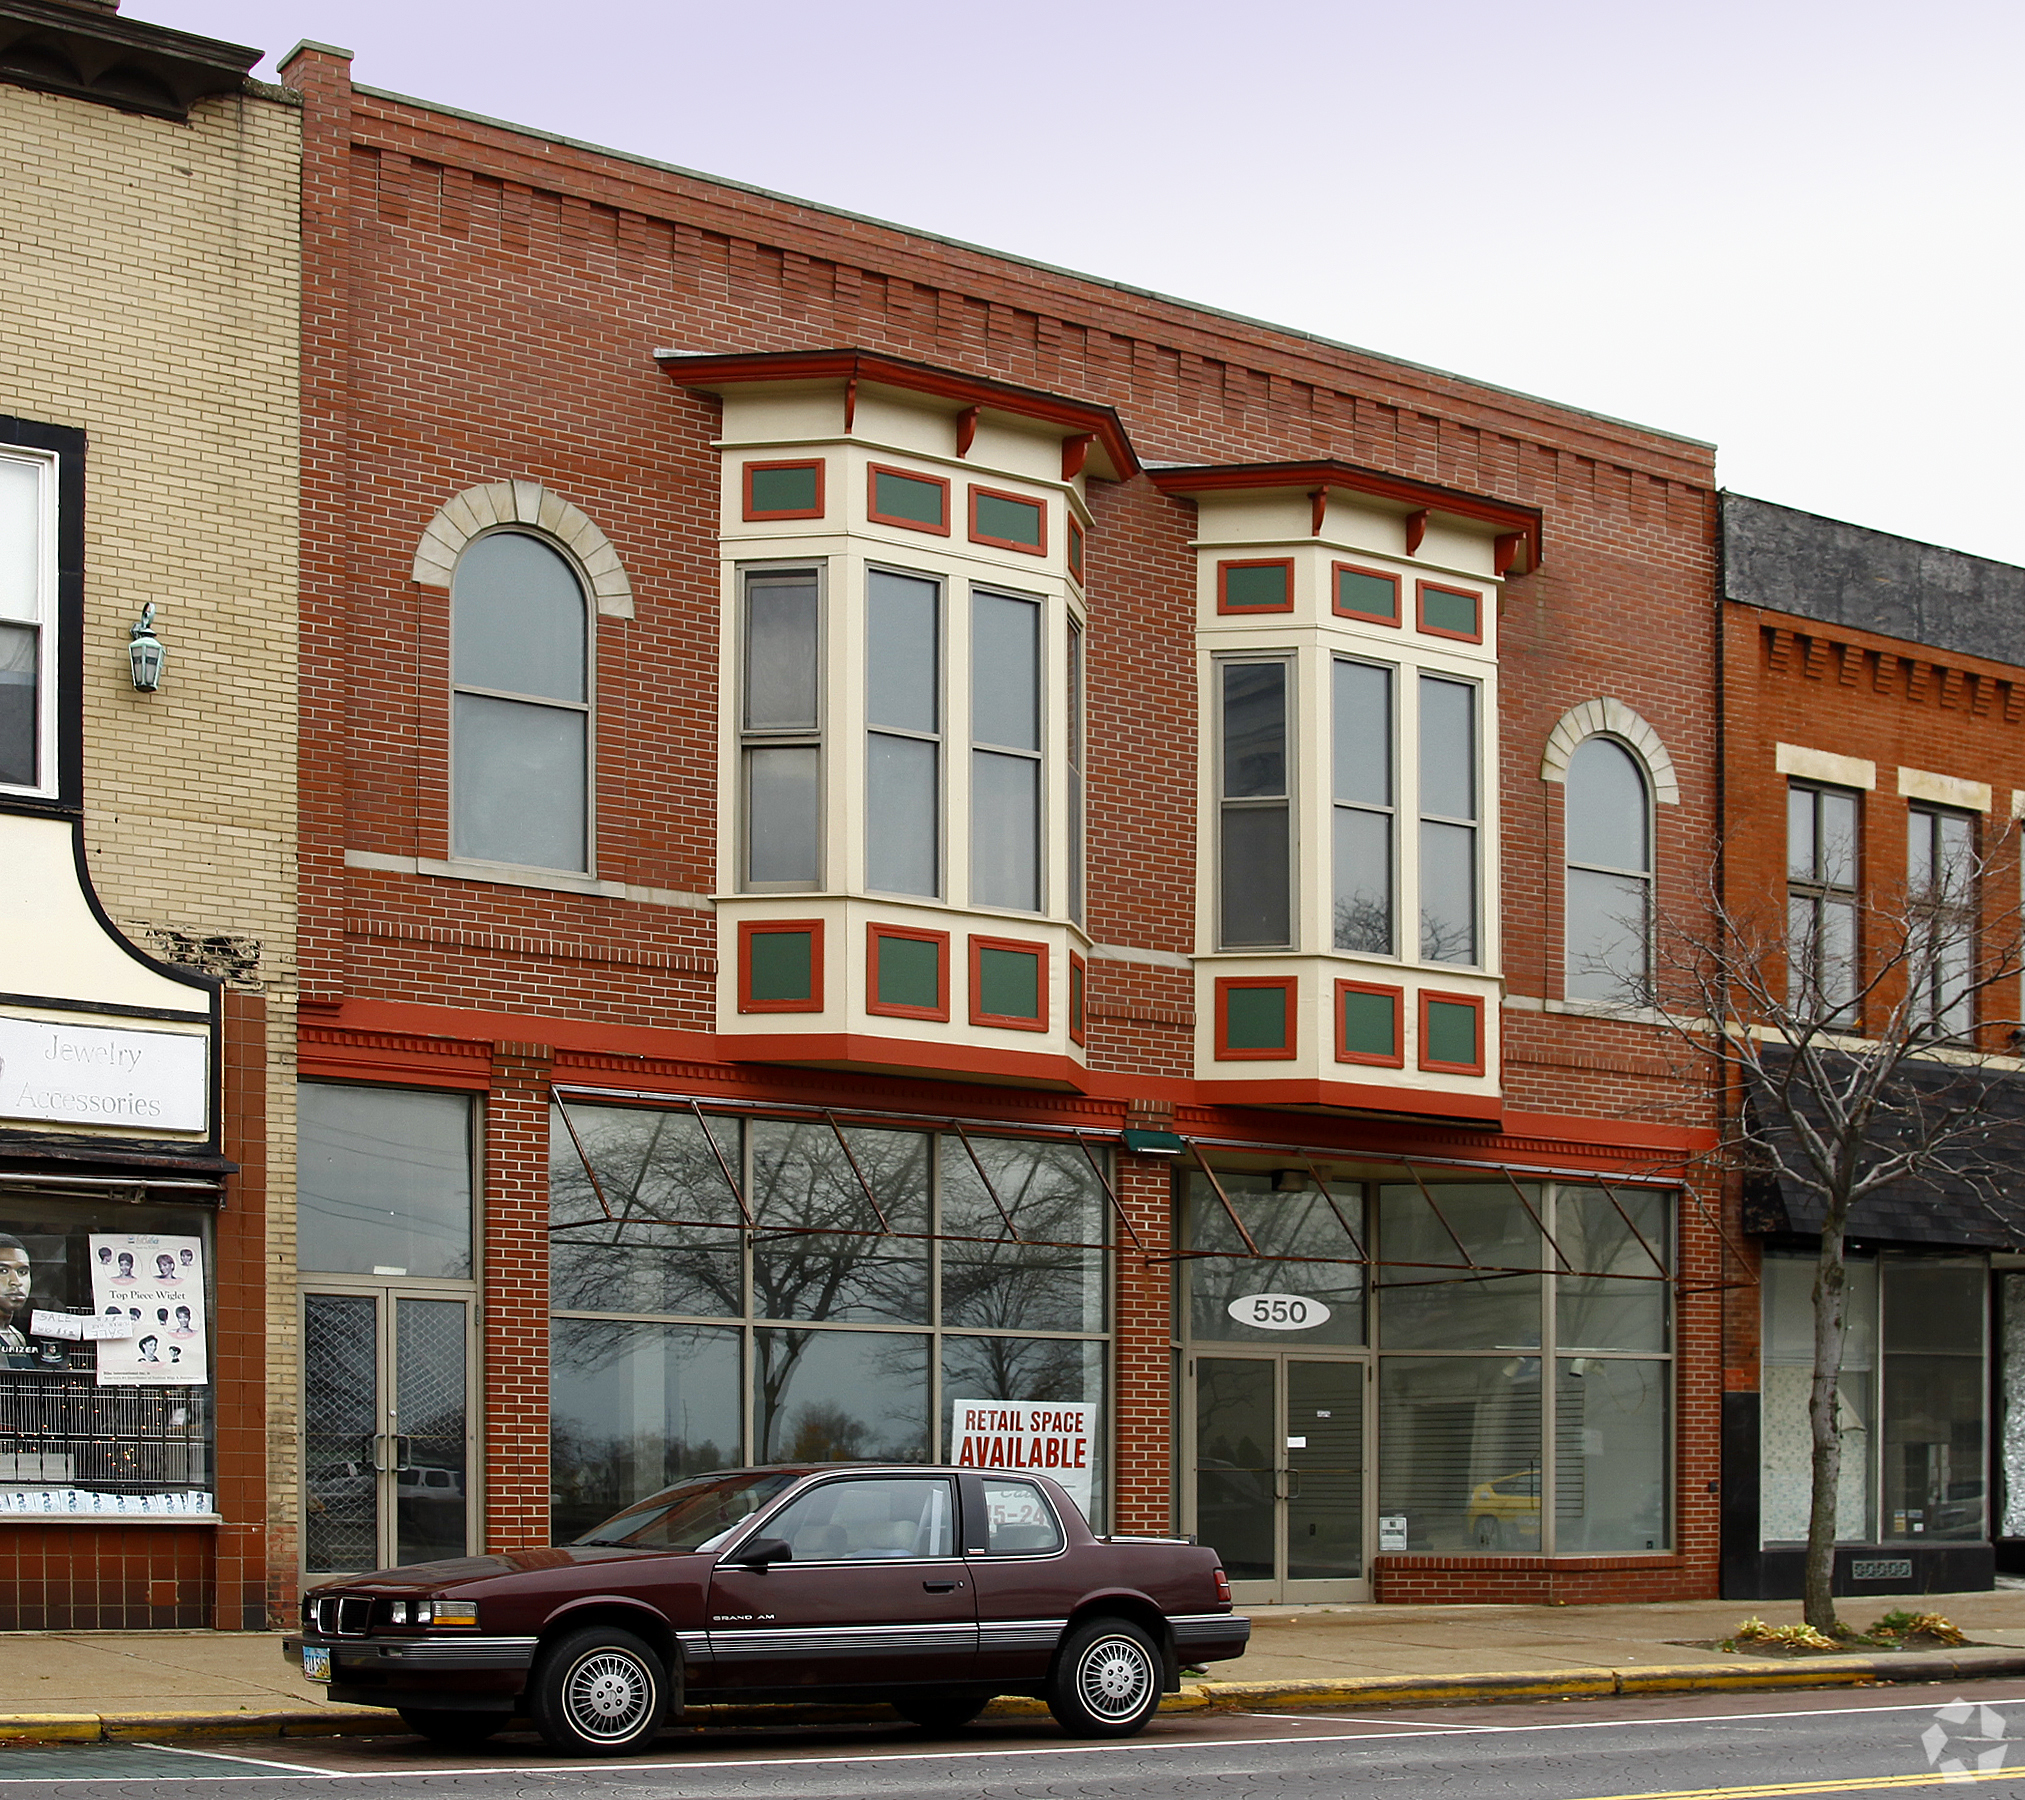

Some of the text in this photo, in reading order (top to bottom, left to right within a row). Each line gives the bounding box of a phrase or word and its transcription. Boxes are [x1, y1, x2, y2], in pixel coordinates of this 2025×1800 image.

[44, 1034, 142, 1073] Jewelry
[16, 1082, 162, 1117] Accessories
[109, 1290, 186, 1301] Top Piece Wiglet
[39, 1313, 72, 1323] SALE
[1252, 1299, 1308, 1324] 550
[965, 1410, 1084, 1433] RETAIL SPACE
[959, 1436, 1087, 1468] AVAILABLE
